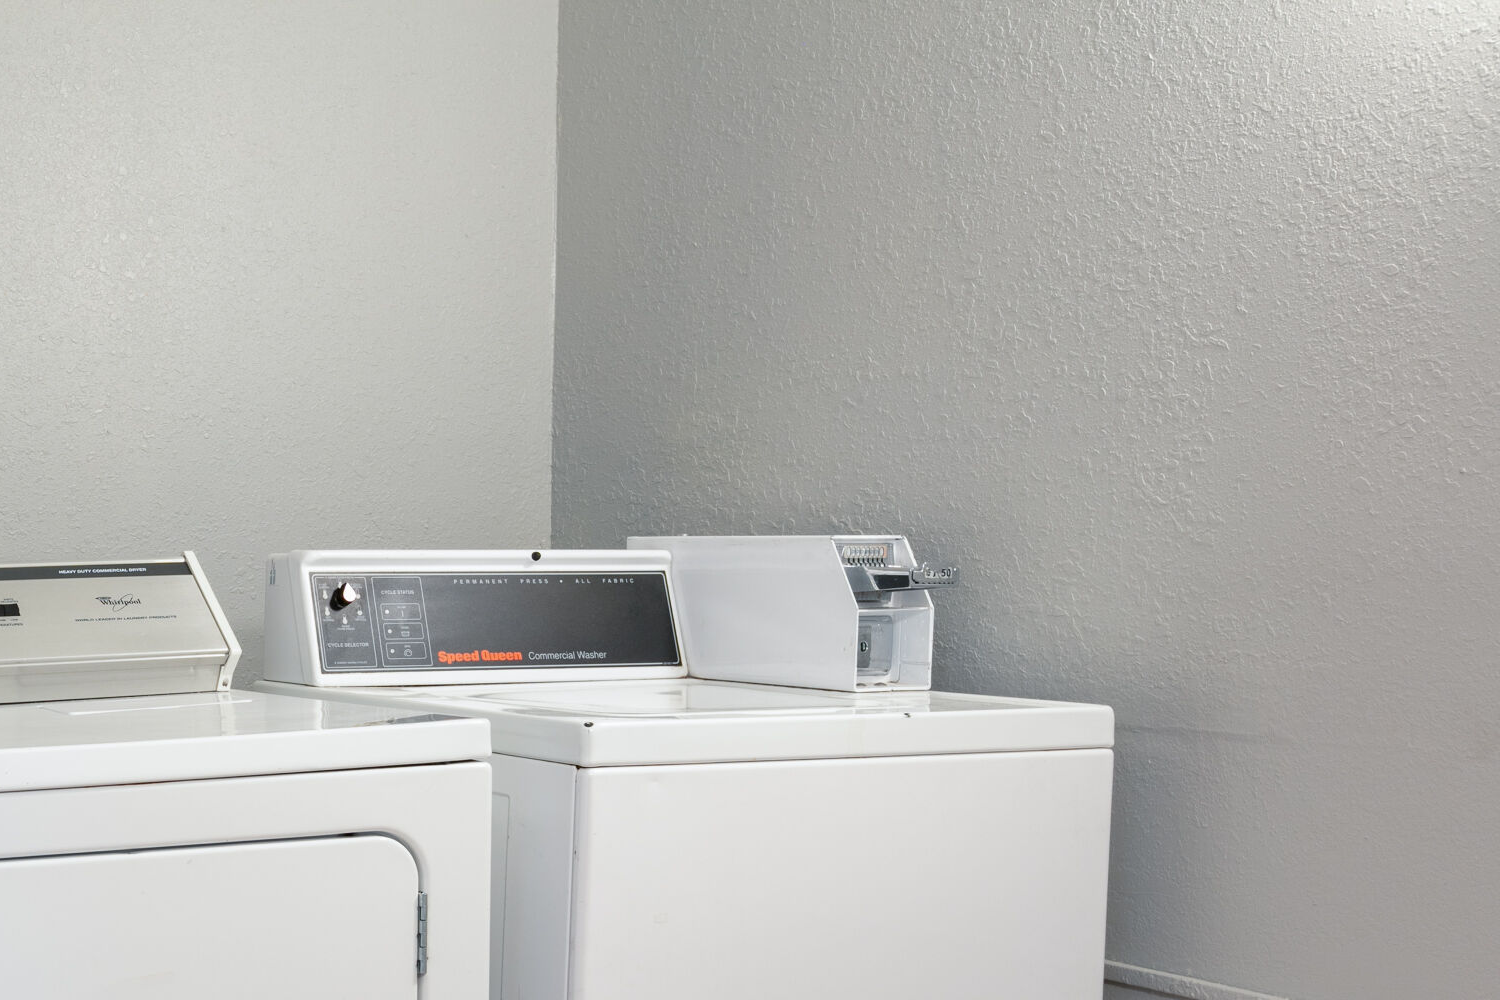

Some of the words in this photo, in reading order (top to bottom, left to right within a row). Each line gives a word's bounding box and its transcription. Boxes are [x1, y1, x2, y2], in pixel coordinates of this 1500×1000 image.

[438, 650, 479, 665] Speed
[481, 649, 523, 662] Queen
[528, 650, 576, 661] Commercial
[576, 650, 608, 660] Washer
